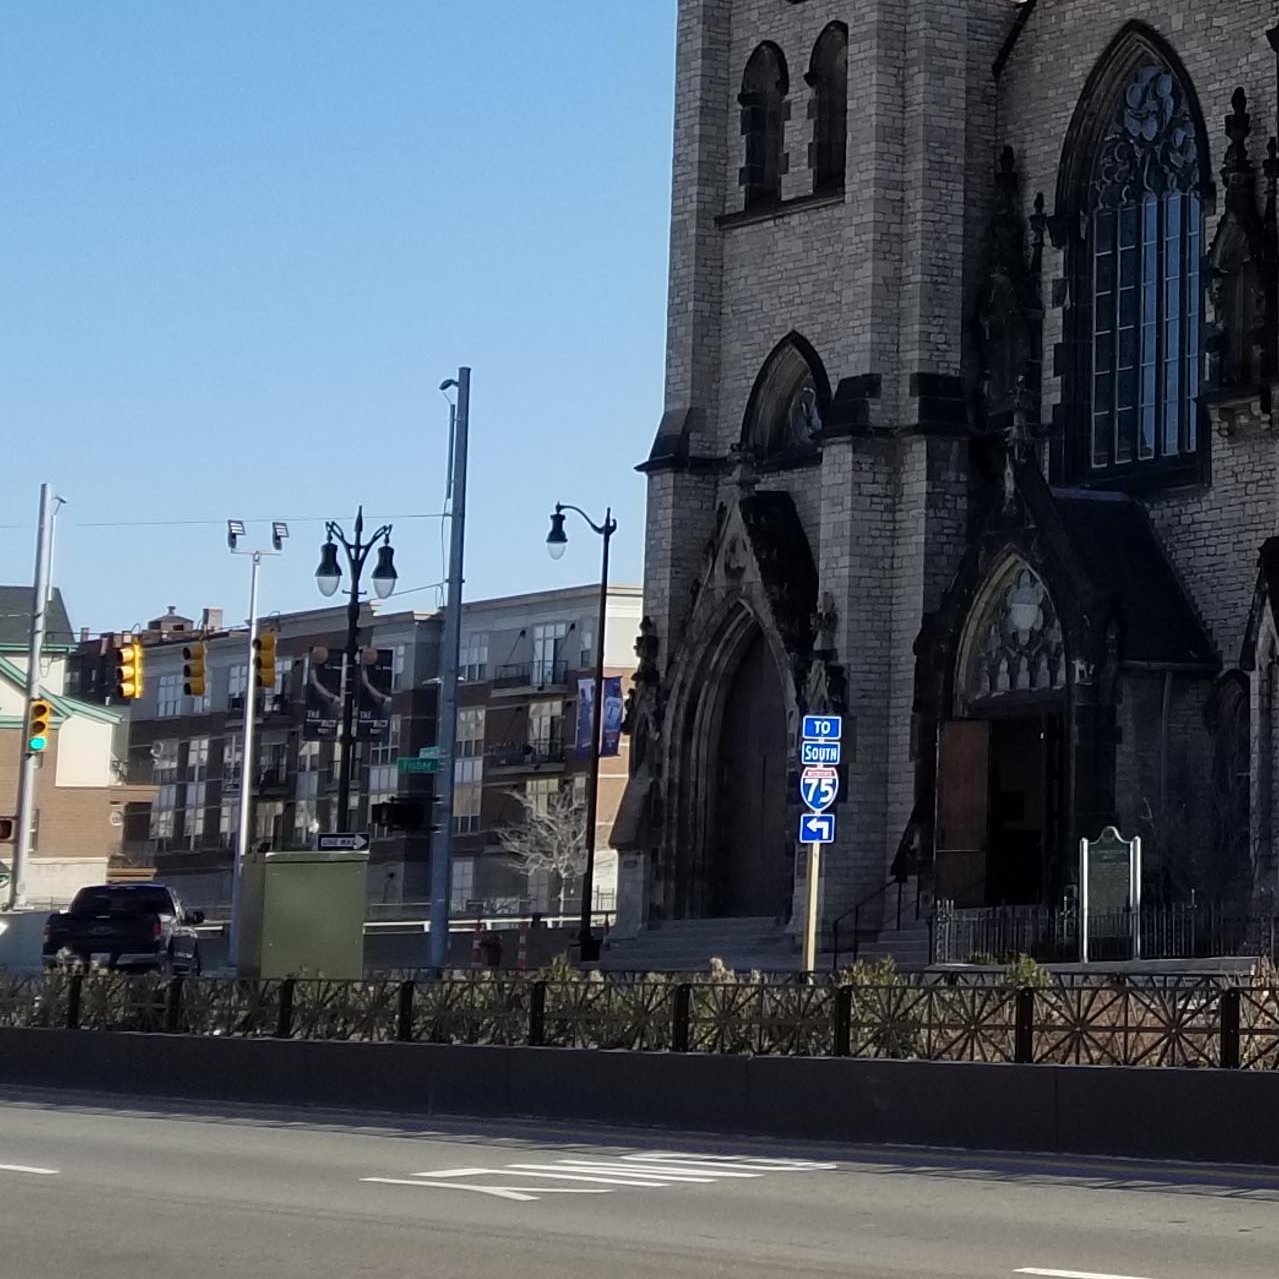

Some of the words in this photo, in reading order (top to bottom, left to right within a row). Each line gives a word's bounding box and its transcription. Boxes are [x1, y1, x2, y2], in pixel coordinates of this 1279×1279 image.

[814, 720, 831, 735] TO
[805, 745, 837, 761] SOUTH
[804, 778, 834, 803] 75
